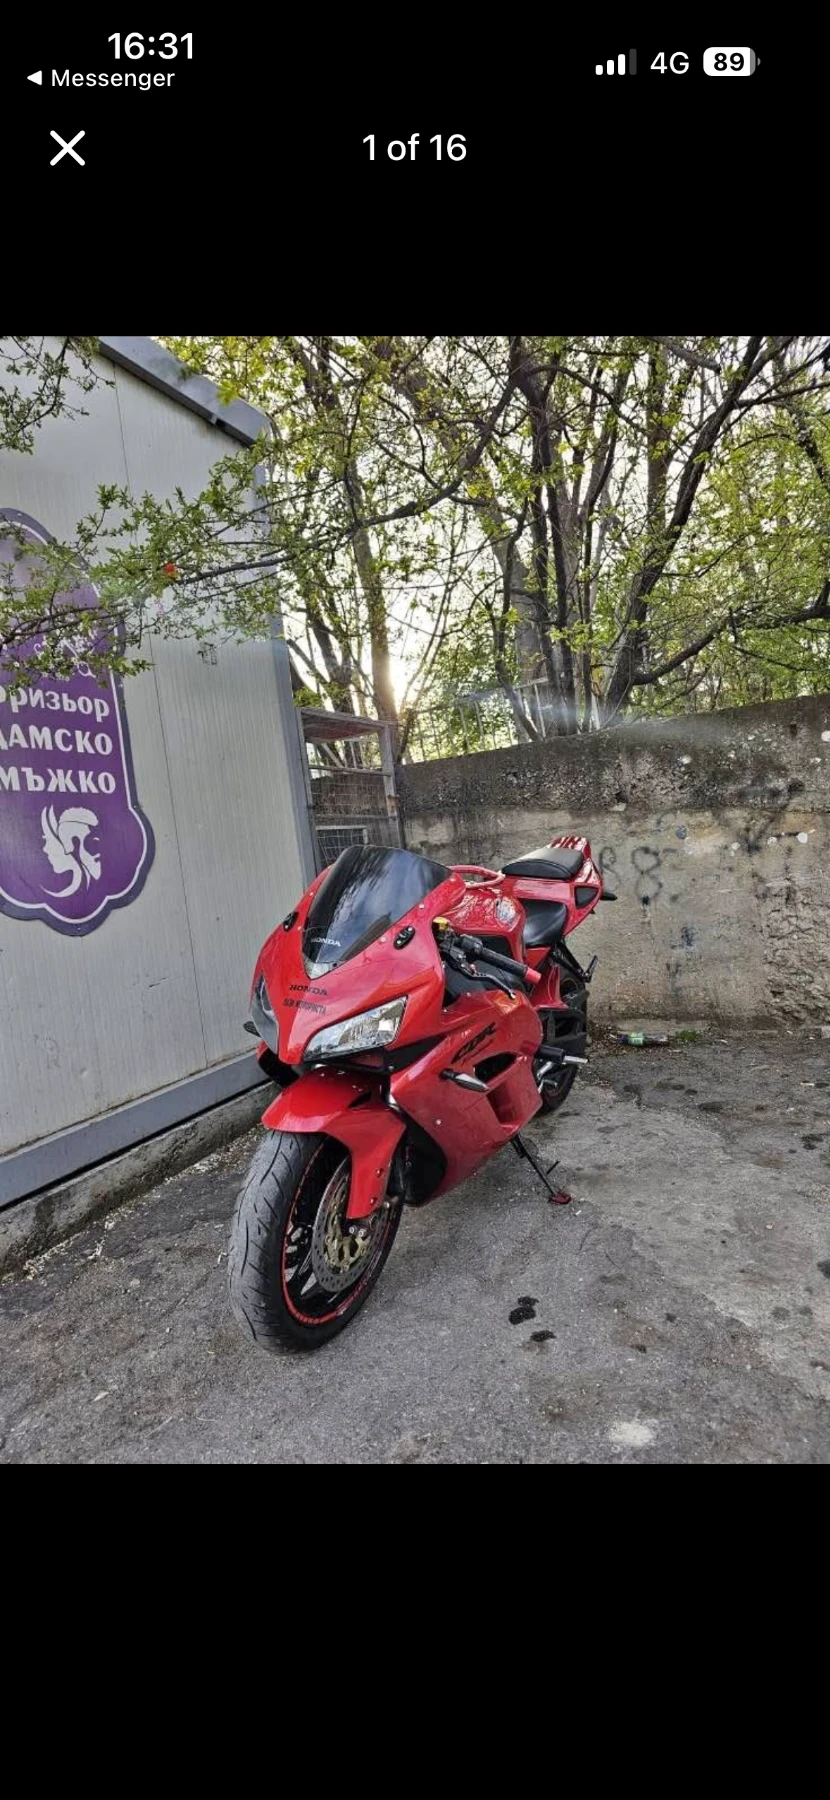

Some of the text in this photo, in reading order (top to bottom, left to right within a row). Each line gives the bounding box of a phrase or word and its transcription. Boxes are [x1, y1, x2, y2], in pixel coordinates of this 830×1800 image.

[0, 766, 117, 794] МЪЖКО
[310, 937, 341, 947] HONDA
[289, 984, 328, 996] HONDA
